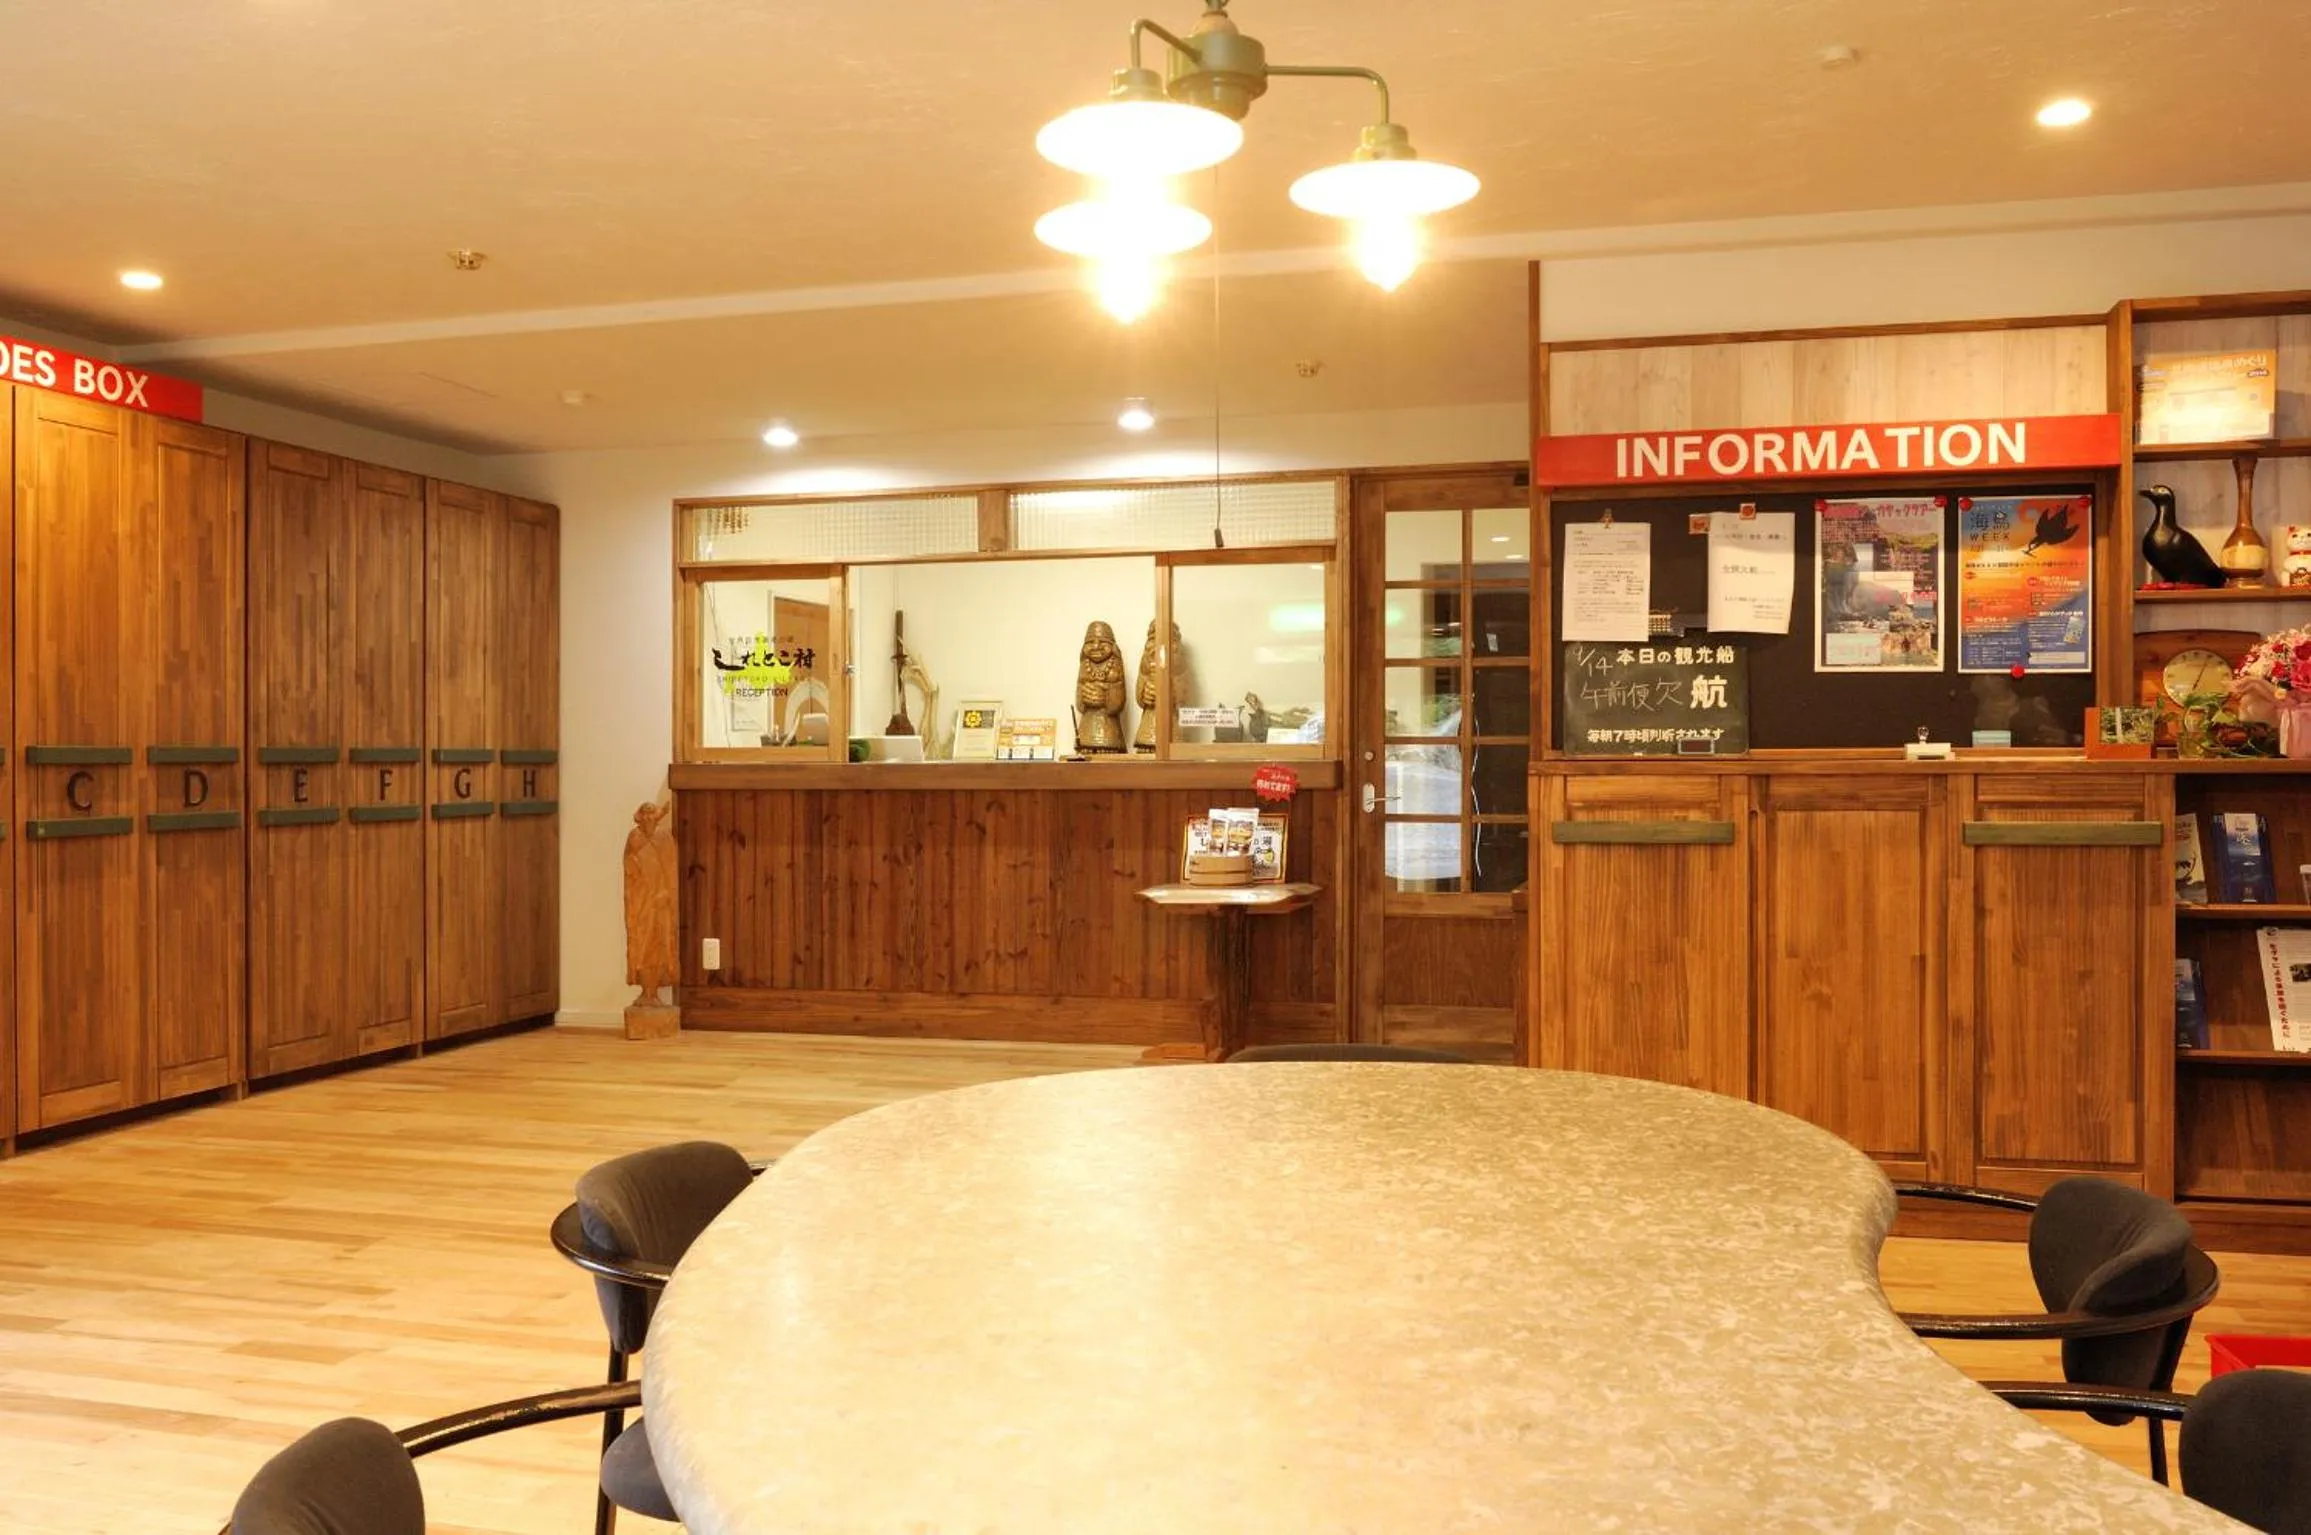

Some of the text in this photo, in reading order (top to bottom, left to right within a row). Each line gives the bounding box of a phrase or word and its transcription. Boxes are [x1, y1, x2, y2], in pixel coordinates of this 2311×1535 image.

[74, 358, 149, 408] BOX
[1616, 421, 2027, 478] INFORMATION
[712, 647, 816, 671] しれとこ村
[1616, 646, 1734, 665] 本日の観光船
[736, 688, 788, 697] RECEPTION
[66, 770, 95, 812] C
[183, 768, 209, 807] D
[293, 768, 309, 803] E
[379, 769, 394, 801] F
[455, 769, 471, 799] G
[523, 769, 536, 798] H
